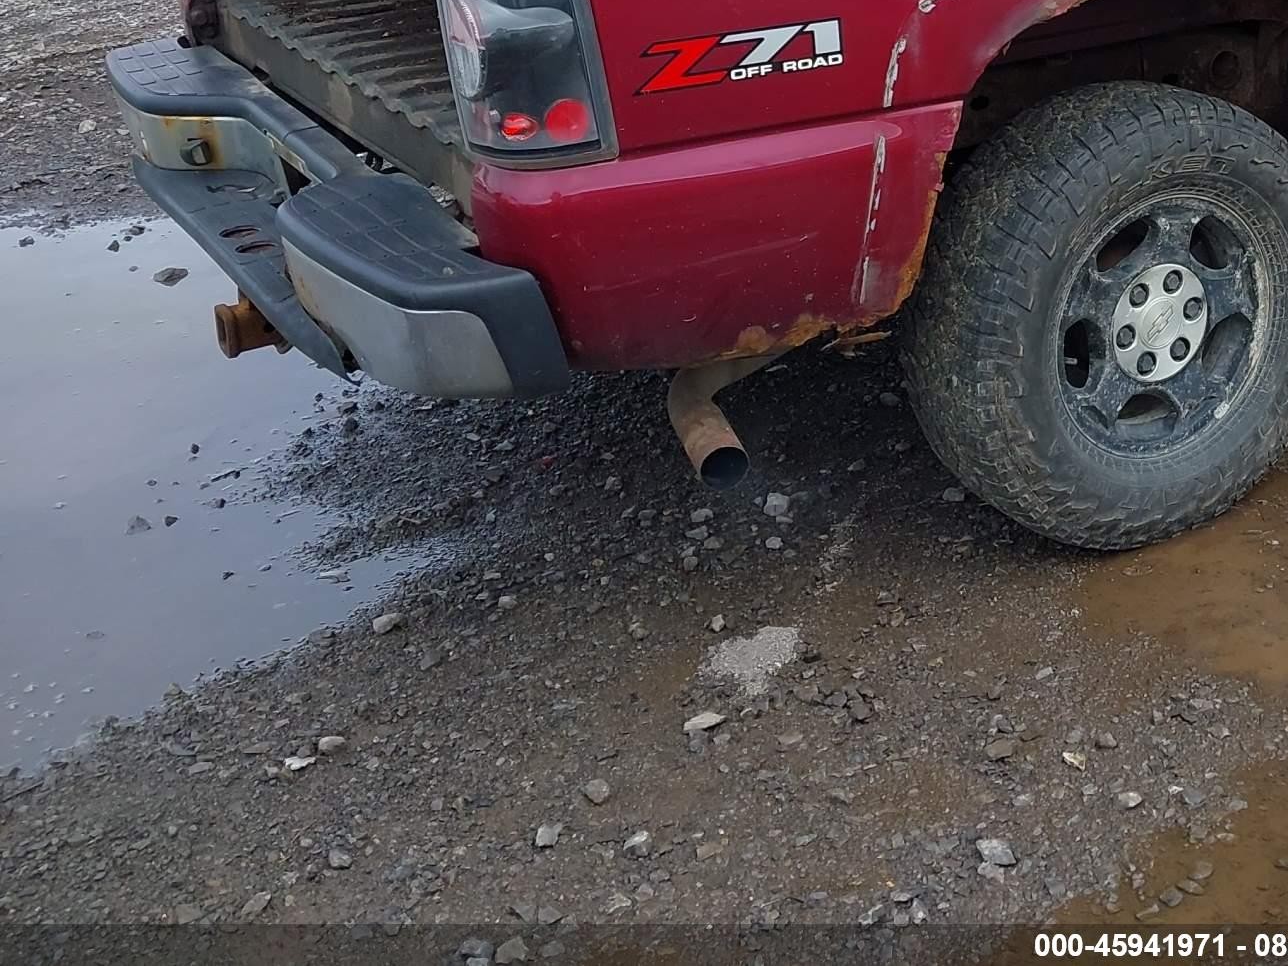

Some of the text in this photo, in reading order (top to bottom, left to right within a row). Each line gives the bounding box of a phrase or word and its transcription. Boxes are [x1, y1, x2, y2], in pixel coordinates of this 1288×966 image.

[636, 18, 842, 94] Z71
[730, 53, 844, 81] OFF ROAD
